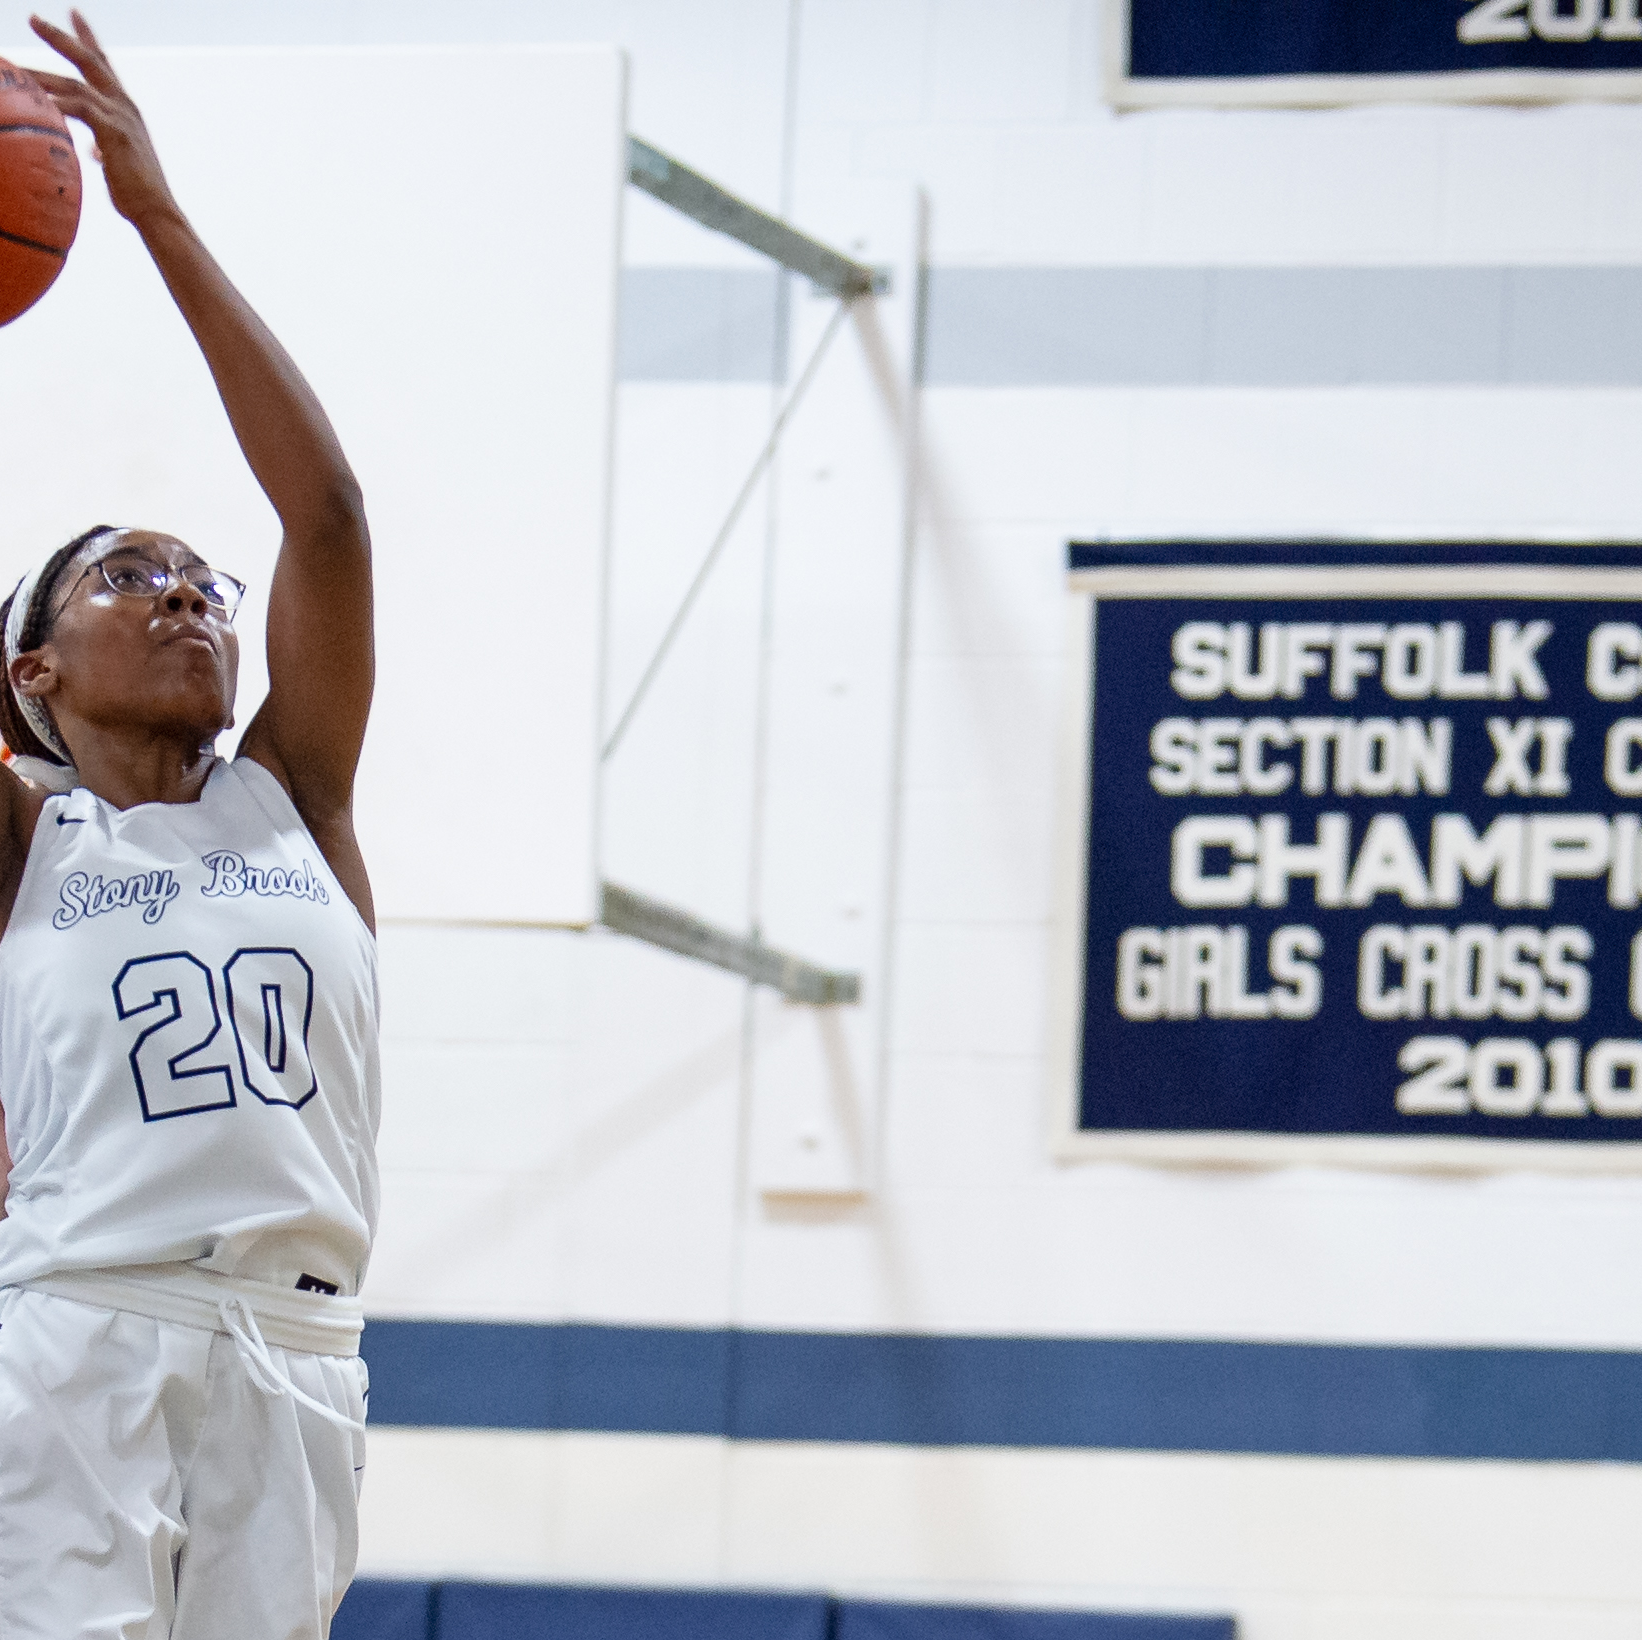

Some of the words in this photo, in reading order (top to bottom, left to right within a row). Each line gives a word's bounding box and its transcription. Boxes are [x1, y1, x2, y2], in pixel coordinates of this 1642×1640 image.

[1169, 619, 1554, 700] SUFFOLK
[1148, 715, 1453, 797] SECTION
[1483, 716, 1573, 798] XI
[53, 869, 180, 931] Stony
[201, 849, 330, 905] Brook
[1115, 923, 1325, 1021] GIRLS
[1356, 923, 1595, 1022] CROSS
[112, 947, 318, 1122] 20
